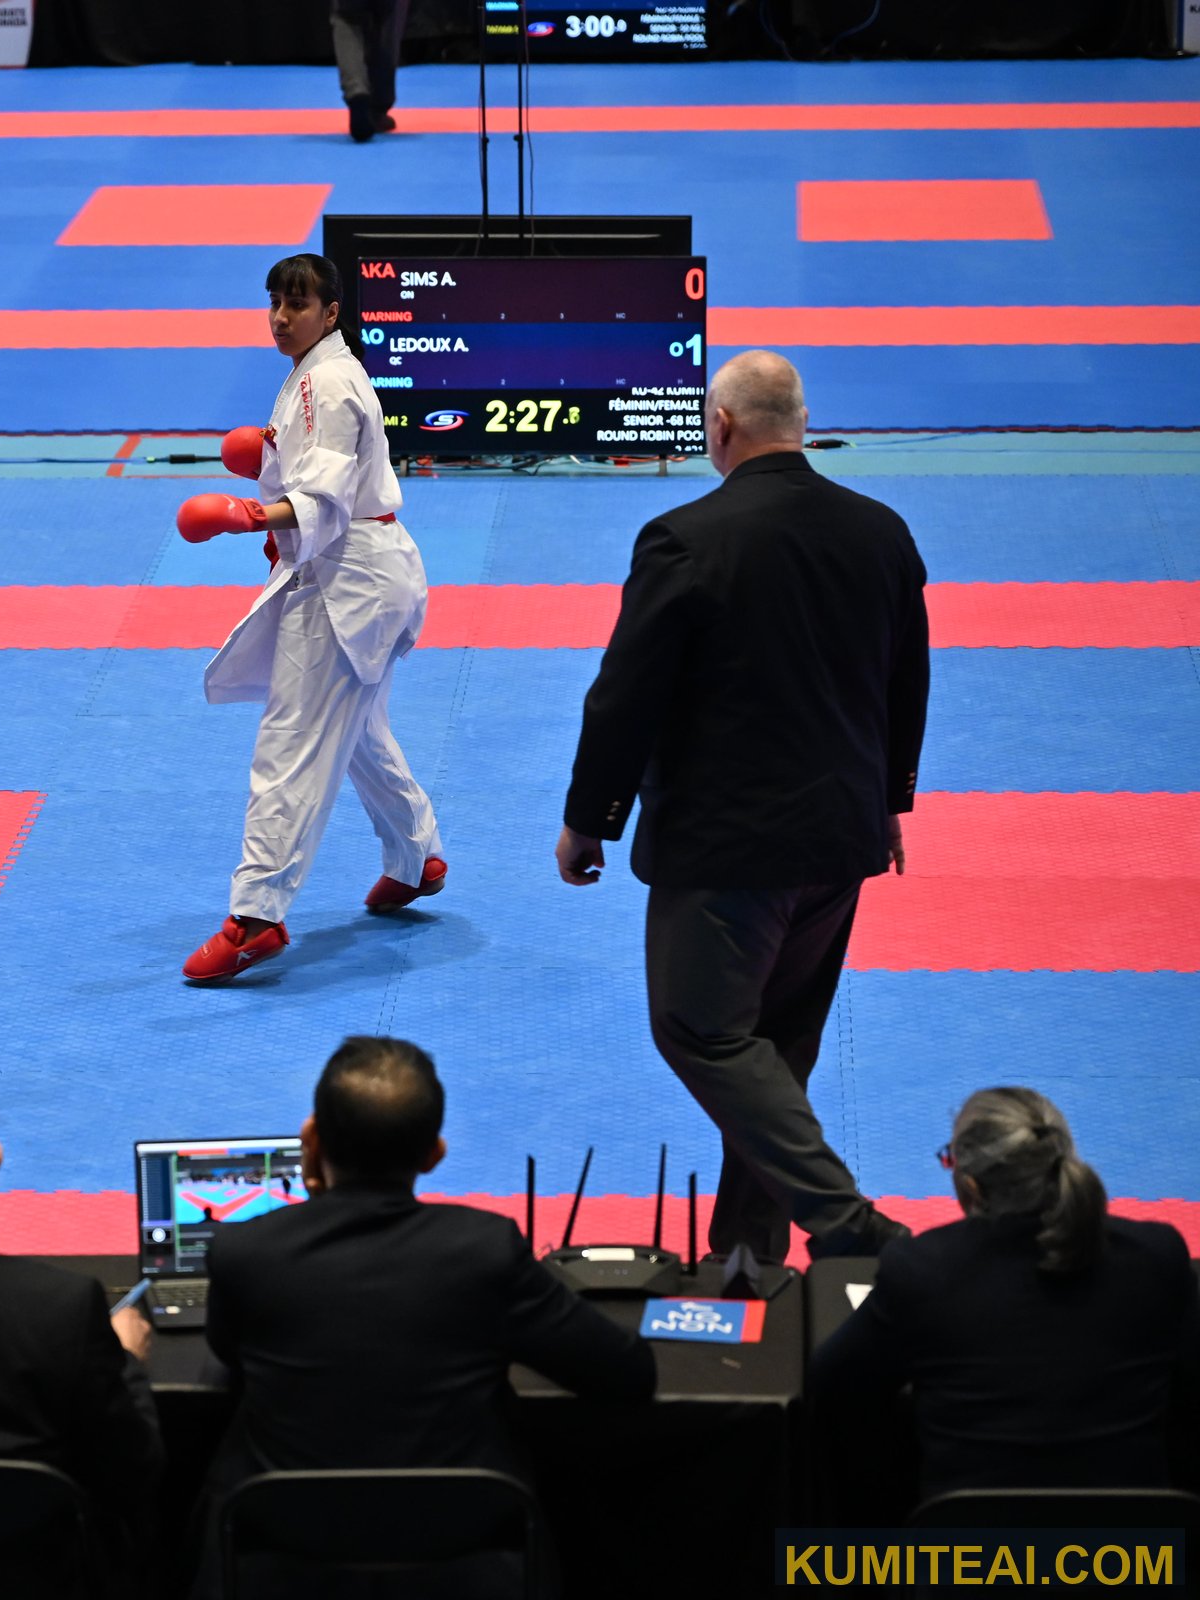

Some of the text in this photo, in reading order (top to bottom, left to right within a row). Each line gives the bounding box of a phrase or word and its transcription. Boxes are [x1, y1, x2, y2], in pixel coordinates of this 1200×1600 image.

[400, 271, 457, 286] SIMS A.
[685, 267, 704, 300] 0
[400, 290, 415, 299] ON
[390, 337, 469, 353] LEDOUX A.
[389, 356, 402, 366] QC
[369, 377, 414, 388] ARNING
[608, 397, 700, 412] FÉMININ/FEMALE
[400, 415, 408, 427] 2
[623, 415, 702, 426] SENIOR -68 KG
[596, 430, 638, 441] ROUND
[639, 430, 675, 441] ROBIN
[651, 1318, 733, 1334] NON
